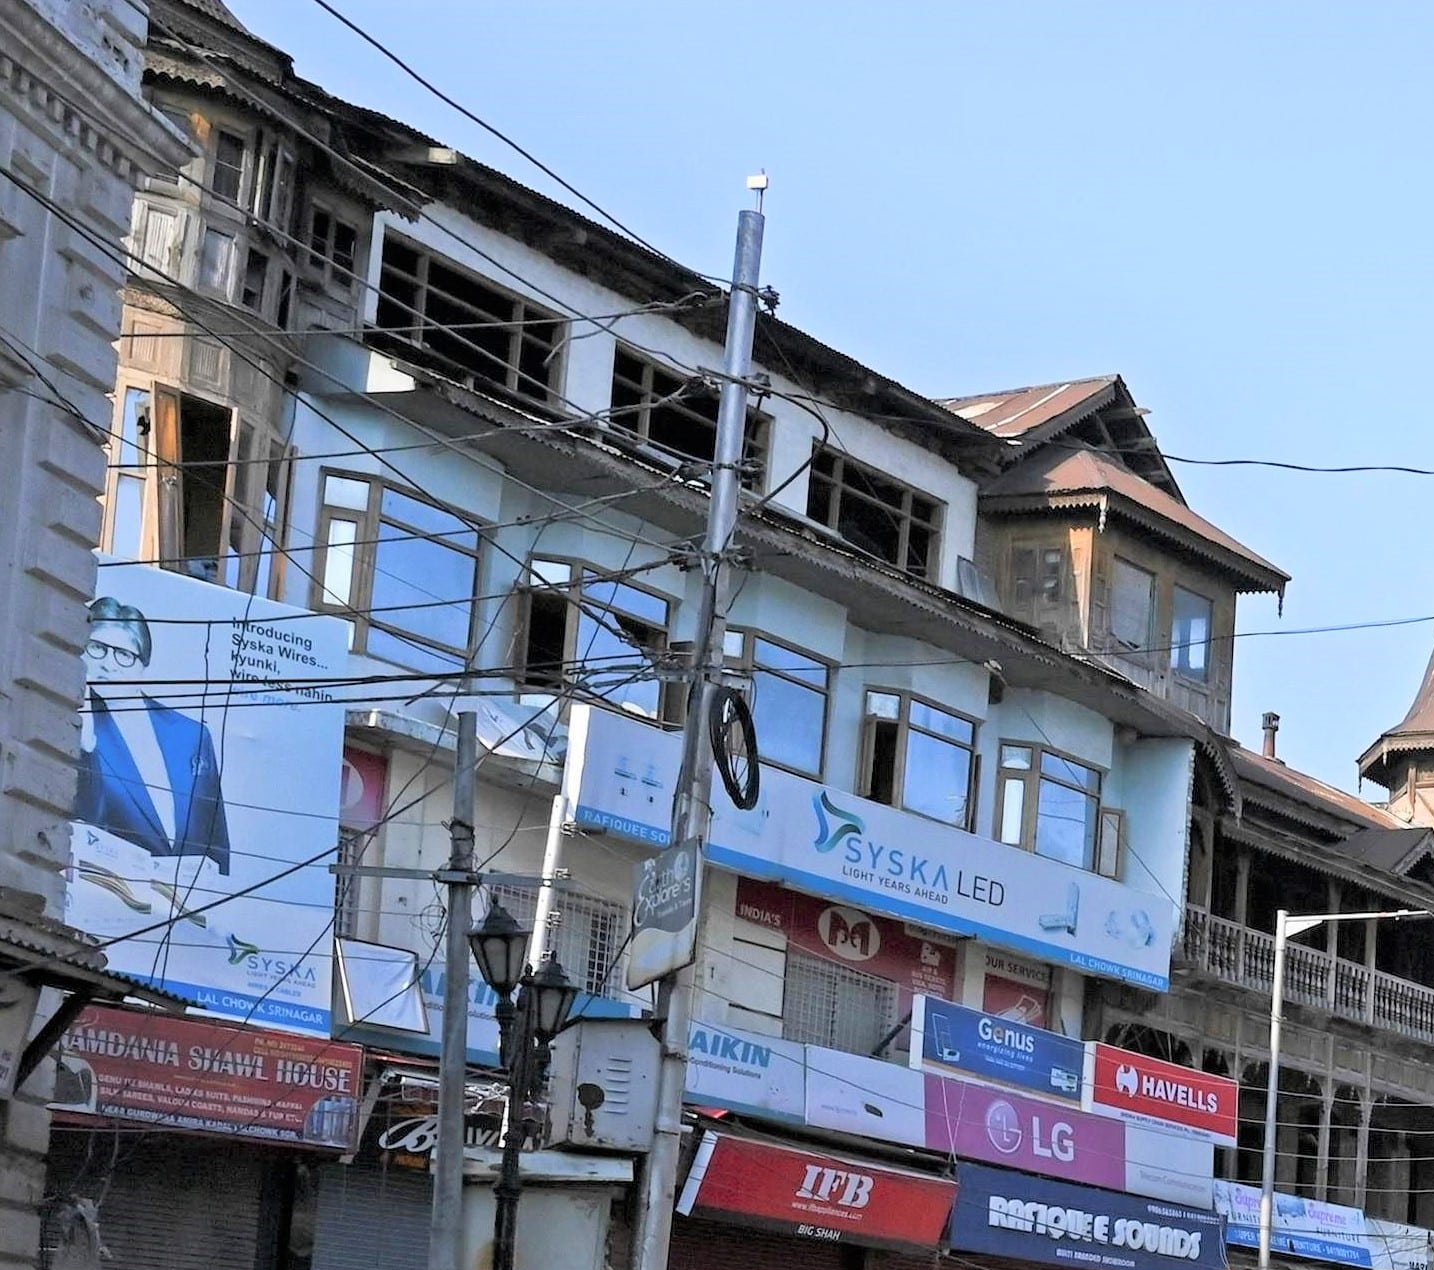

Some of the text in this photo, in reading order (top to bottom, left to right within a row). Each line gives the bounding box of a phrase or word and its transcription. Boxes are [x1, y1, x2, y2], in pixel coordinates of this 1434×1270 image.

[231, 633, 274, 655] Syska
[232, 617, 313, 651] Introducing
[841, 864, 950, 906] LIGHT YEARS AHEAD
[843, 836, 1006, 907] SYSKA LED
[738, 902, 782, 927] INDIA'S
[1069, 952, 1165, 989] LAL CHOWK SRINAGAR
[268, 1004, 324, 1026] SRINAGAR
[978, 1017, 1036, 1053] Genus
[188, 1045, 269, 1082] SHAWL
[276, 1059, 352, 1094] HOUSE
[1142, 1077, 1218, 1114] HAVELLS
[1032, 1115, 1075, 1163] LG
[795, 1163, 875, 1210] IFB
[797, 1224, 841, 1240] BIG SHAH
[1112, 1216, 1202, 1261] SOUNDS
